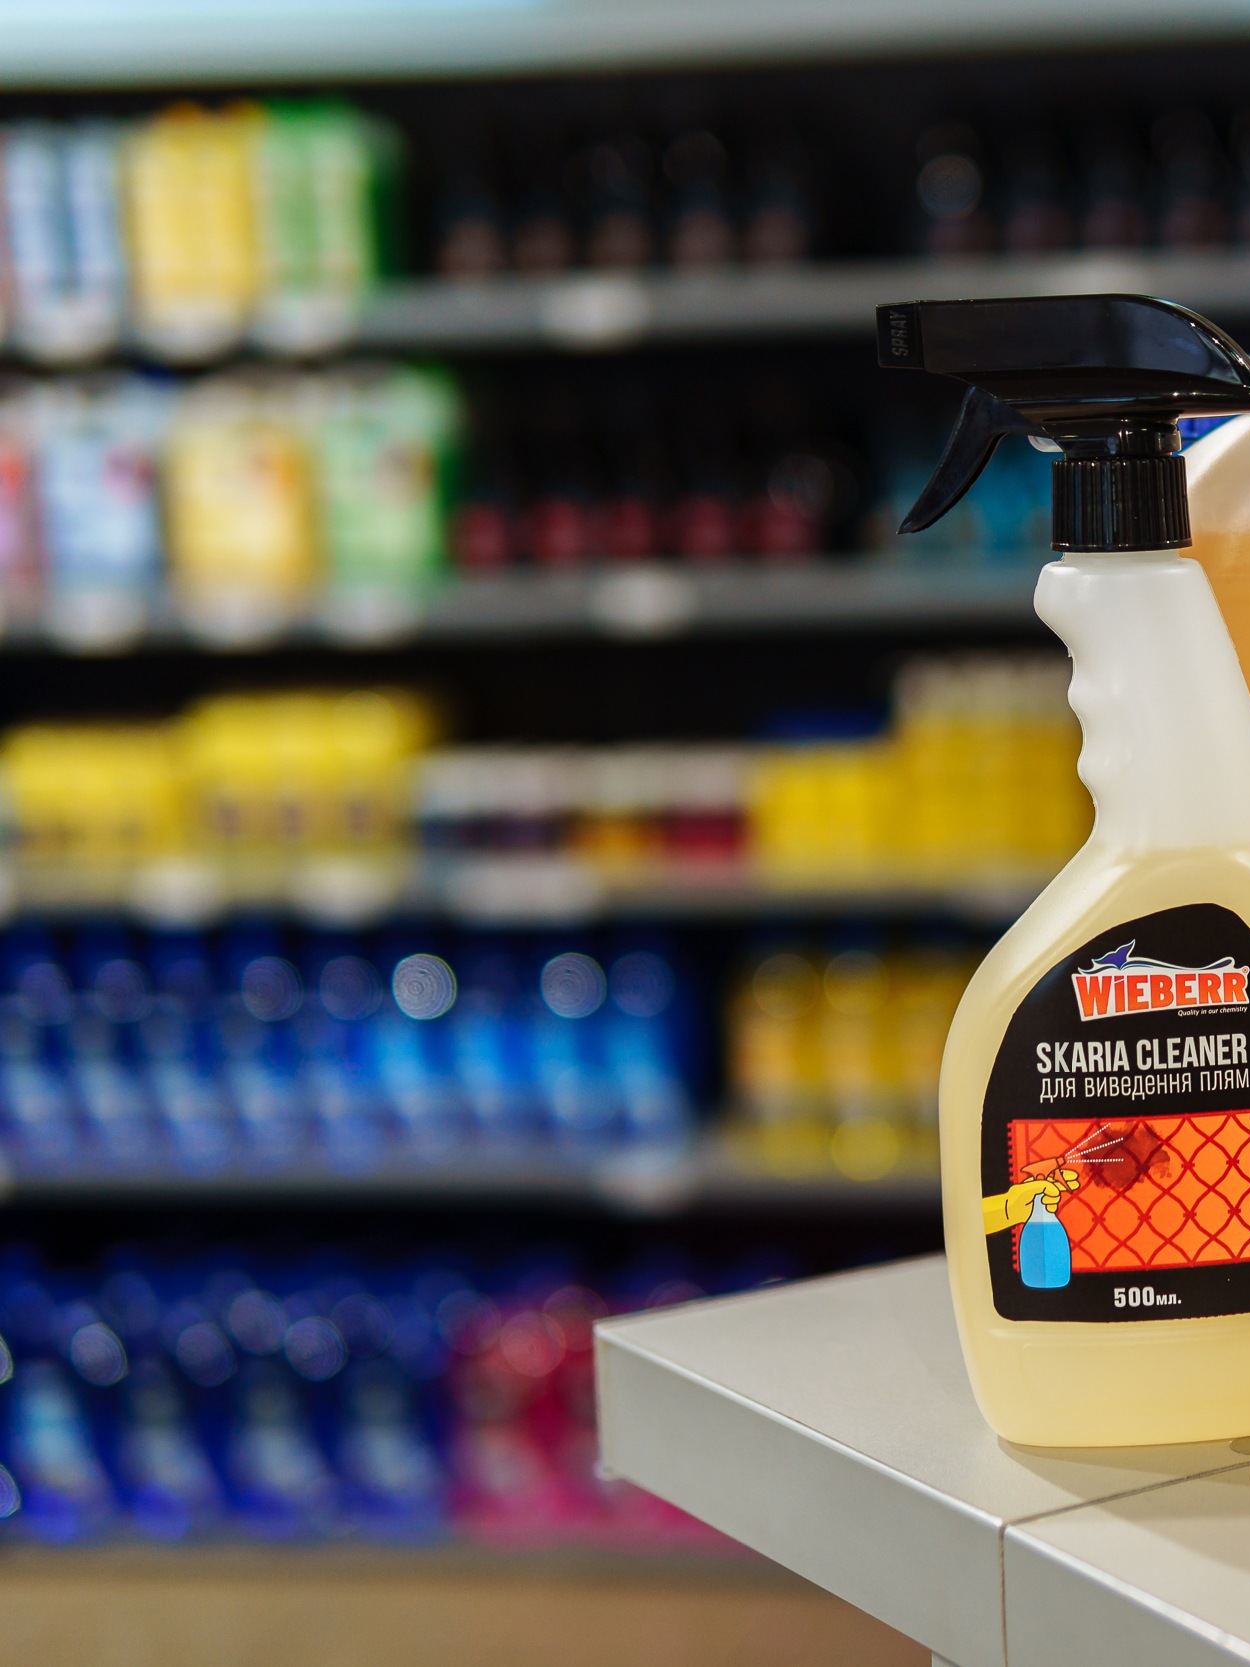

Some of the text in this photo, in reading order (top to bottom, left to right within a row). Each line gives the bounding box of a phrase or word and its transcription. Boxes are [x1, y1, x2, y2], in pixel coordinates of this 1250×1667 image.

[889, 310, 909, 357] SPRAY
[1177, 1009, 1200, 1017] Quality
[1219, 1006, 1248, 1014] chemistry
[1036, 1033, 1248, 1074] SKARIA CLEANER
